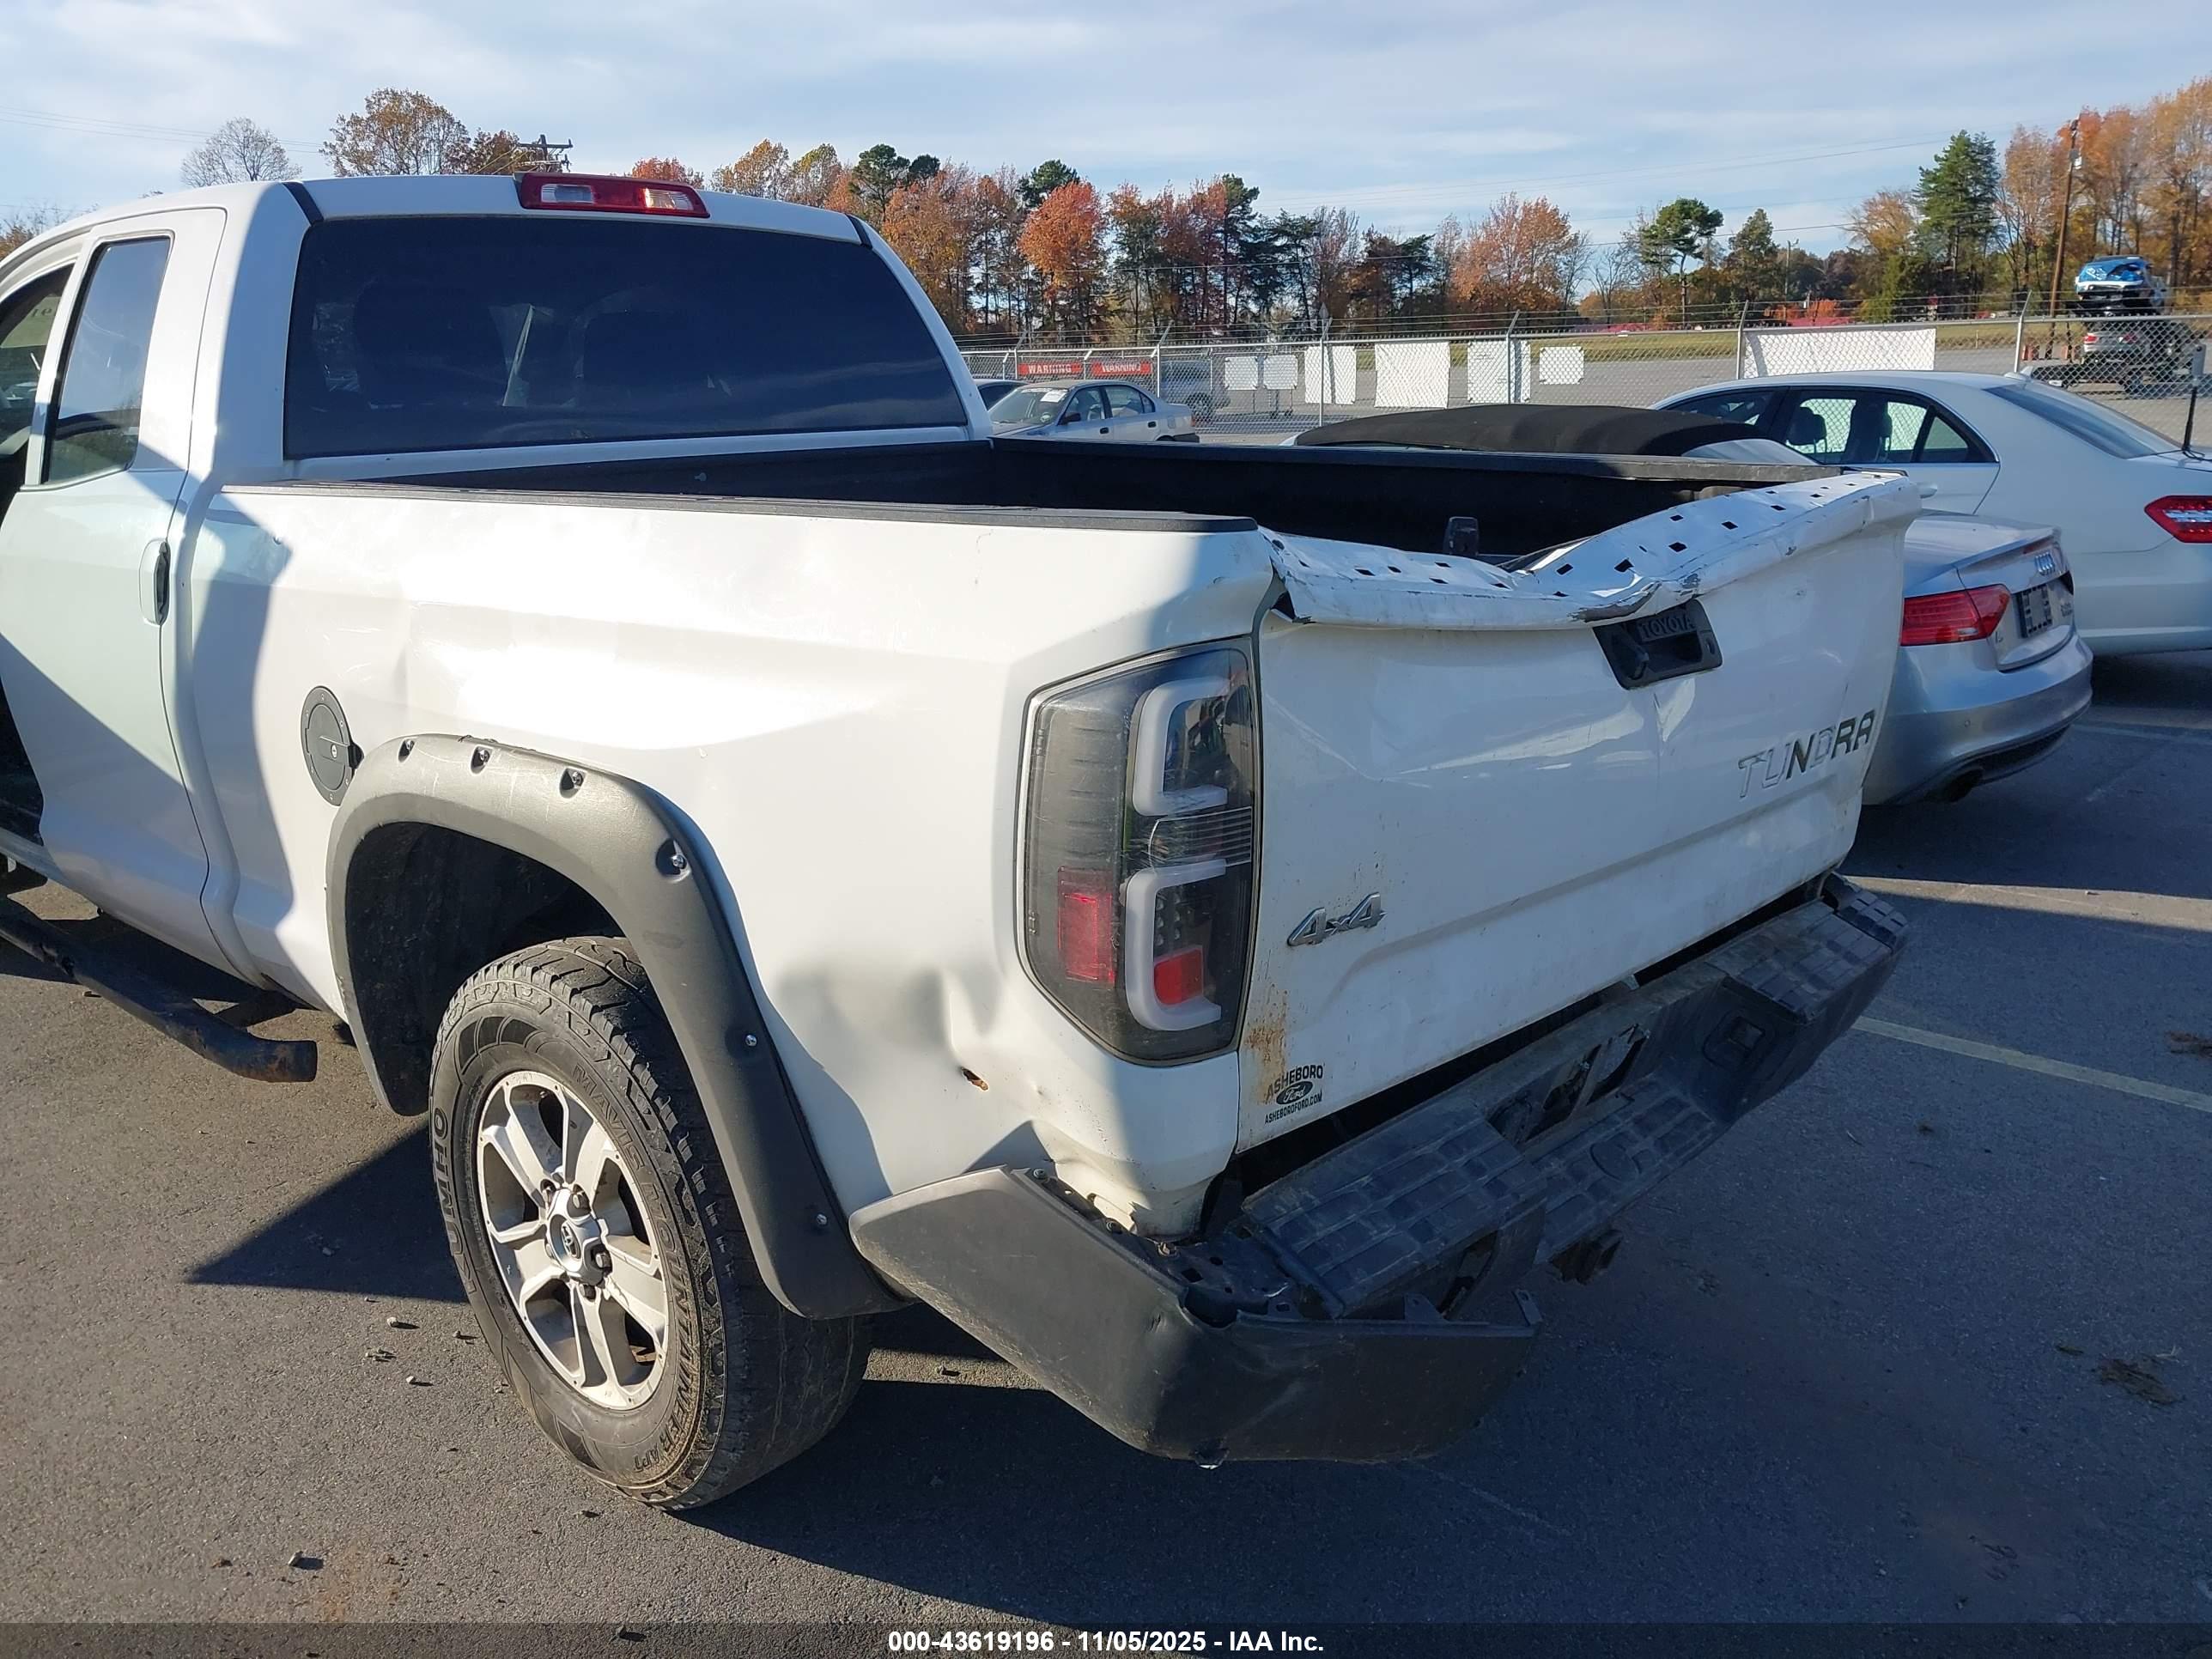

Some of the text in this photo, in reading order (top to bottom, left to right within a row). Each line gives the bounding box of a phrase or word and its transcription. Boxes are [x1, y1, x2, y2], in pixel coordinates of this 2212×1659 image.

[1028, 364, 1073, 374] WARNING
[1102, 362, 1141, 373] WARNING
[1638, 614, 1695, 639] TOYOTA
[1737, 708, 1875, 799] TUNDRA
[1264, 1064, 1324, 1105] ASHEBORO
[1283, 1084, 1306, 1103] Ford
[572, 1063, 647, 1173] MAVIS
[1264, 1088, 1323, 1126] ASHEBOROFORD.COM
[433, 1106, 477, 1295] KUMHO
